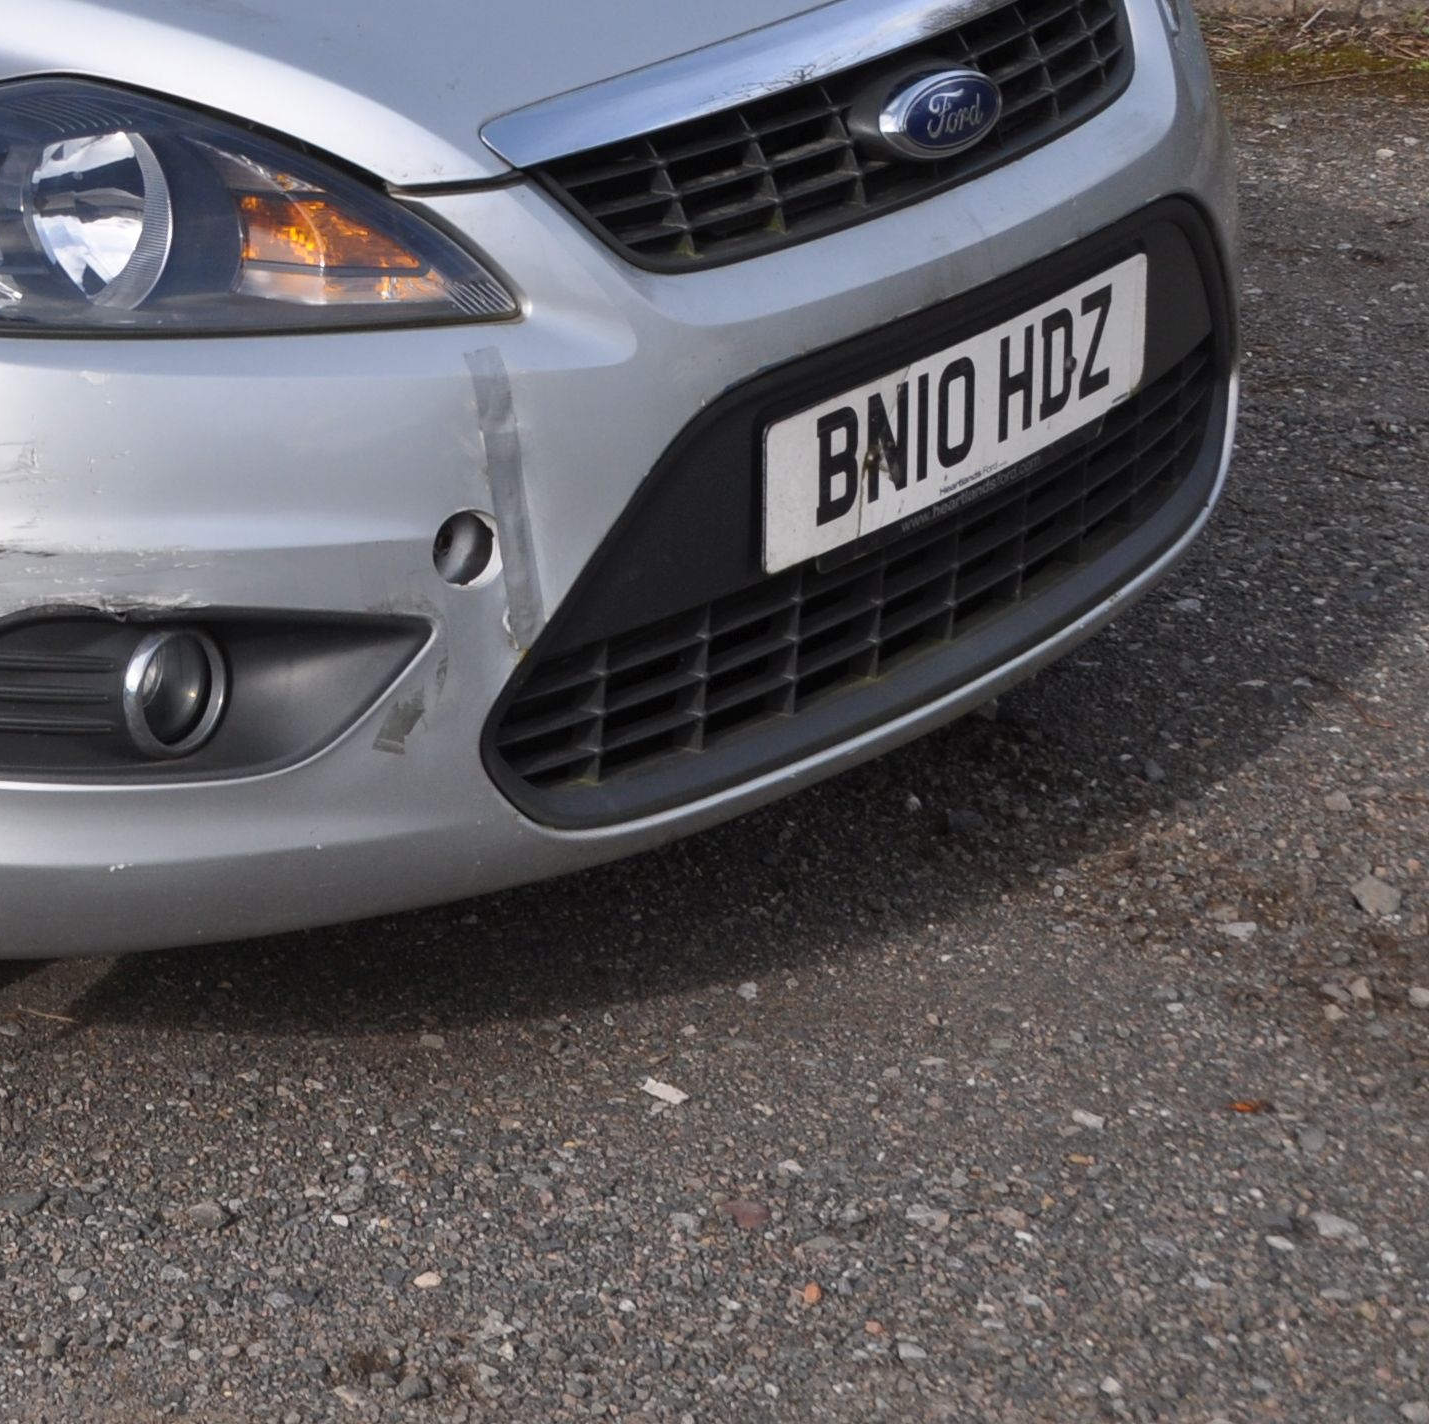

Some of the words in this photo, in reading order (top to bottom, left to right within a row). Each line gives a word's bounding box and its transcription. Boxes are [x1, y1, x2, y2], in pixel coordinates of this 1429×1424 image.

[926, 88, 984, 138] Ford
[815, 355, 976, 528] BN10
[997, 283, 1113, 444] HDZ
[901, 454, 1042, 533] www.heartlandsford.com
